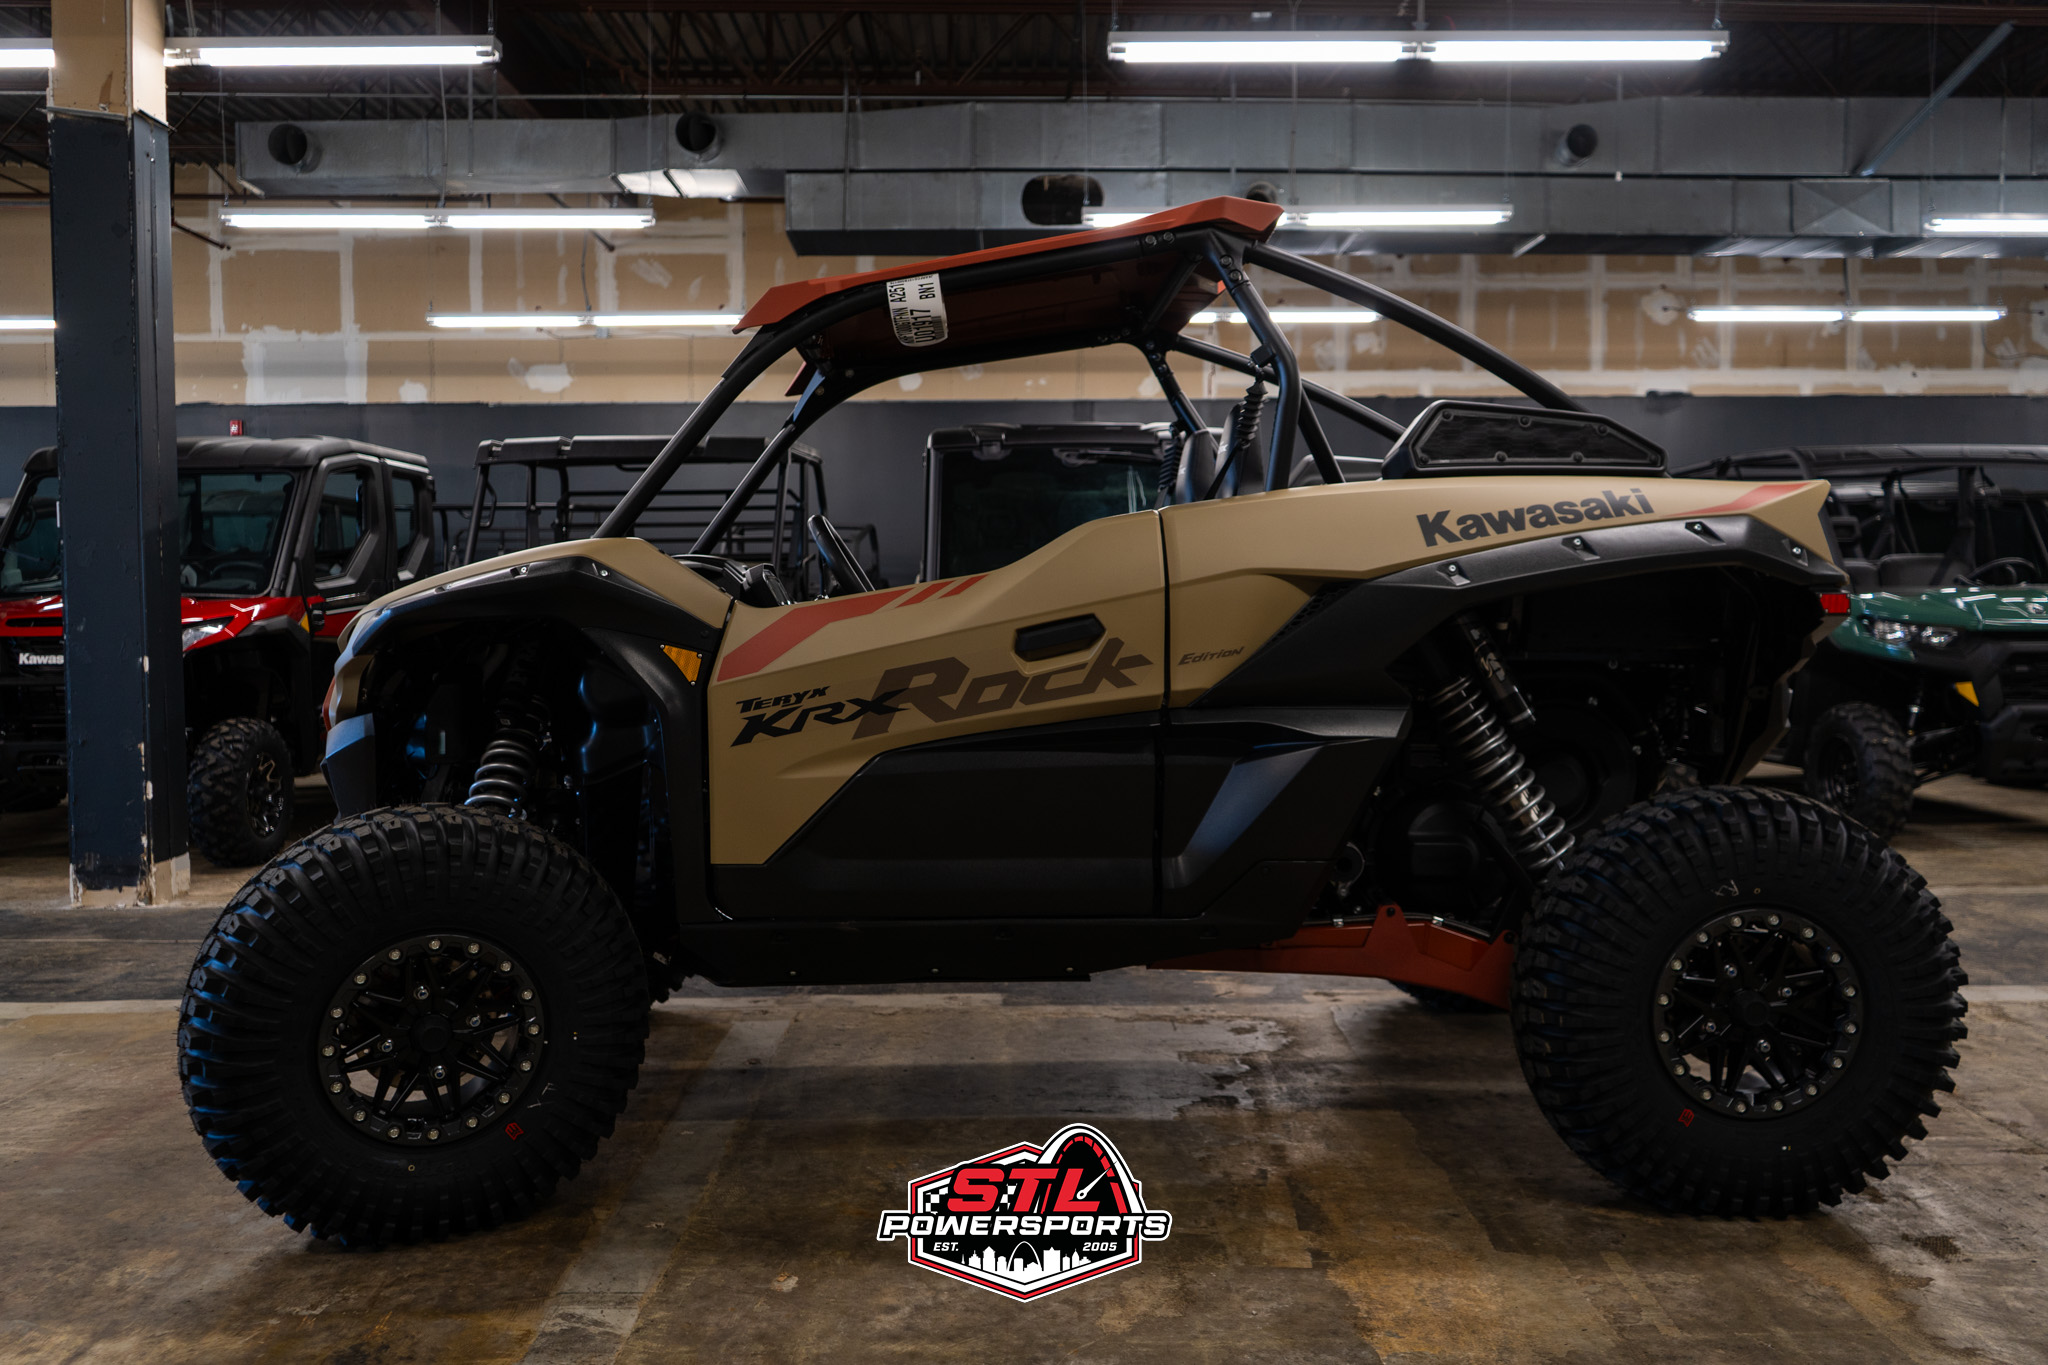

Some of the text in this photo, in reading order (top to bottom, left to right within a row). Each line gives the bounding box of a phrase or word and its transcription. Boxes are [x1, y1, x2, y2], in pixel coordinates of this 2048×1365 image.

[889, 283, 907, 303] A251
[918, 282, 936, 300] BN1
[1416, 488, 1655, 547] Kawasaki
[730, 688, 910, 747] KRX
[852, 637, 1154, 740] Rock
